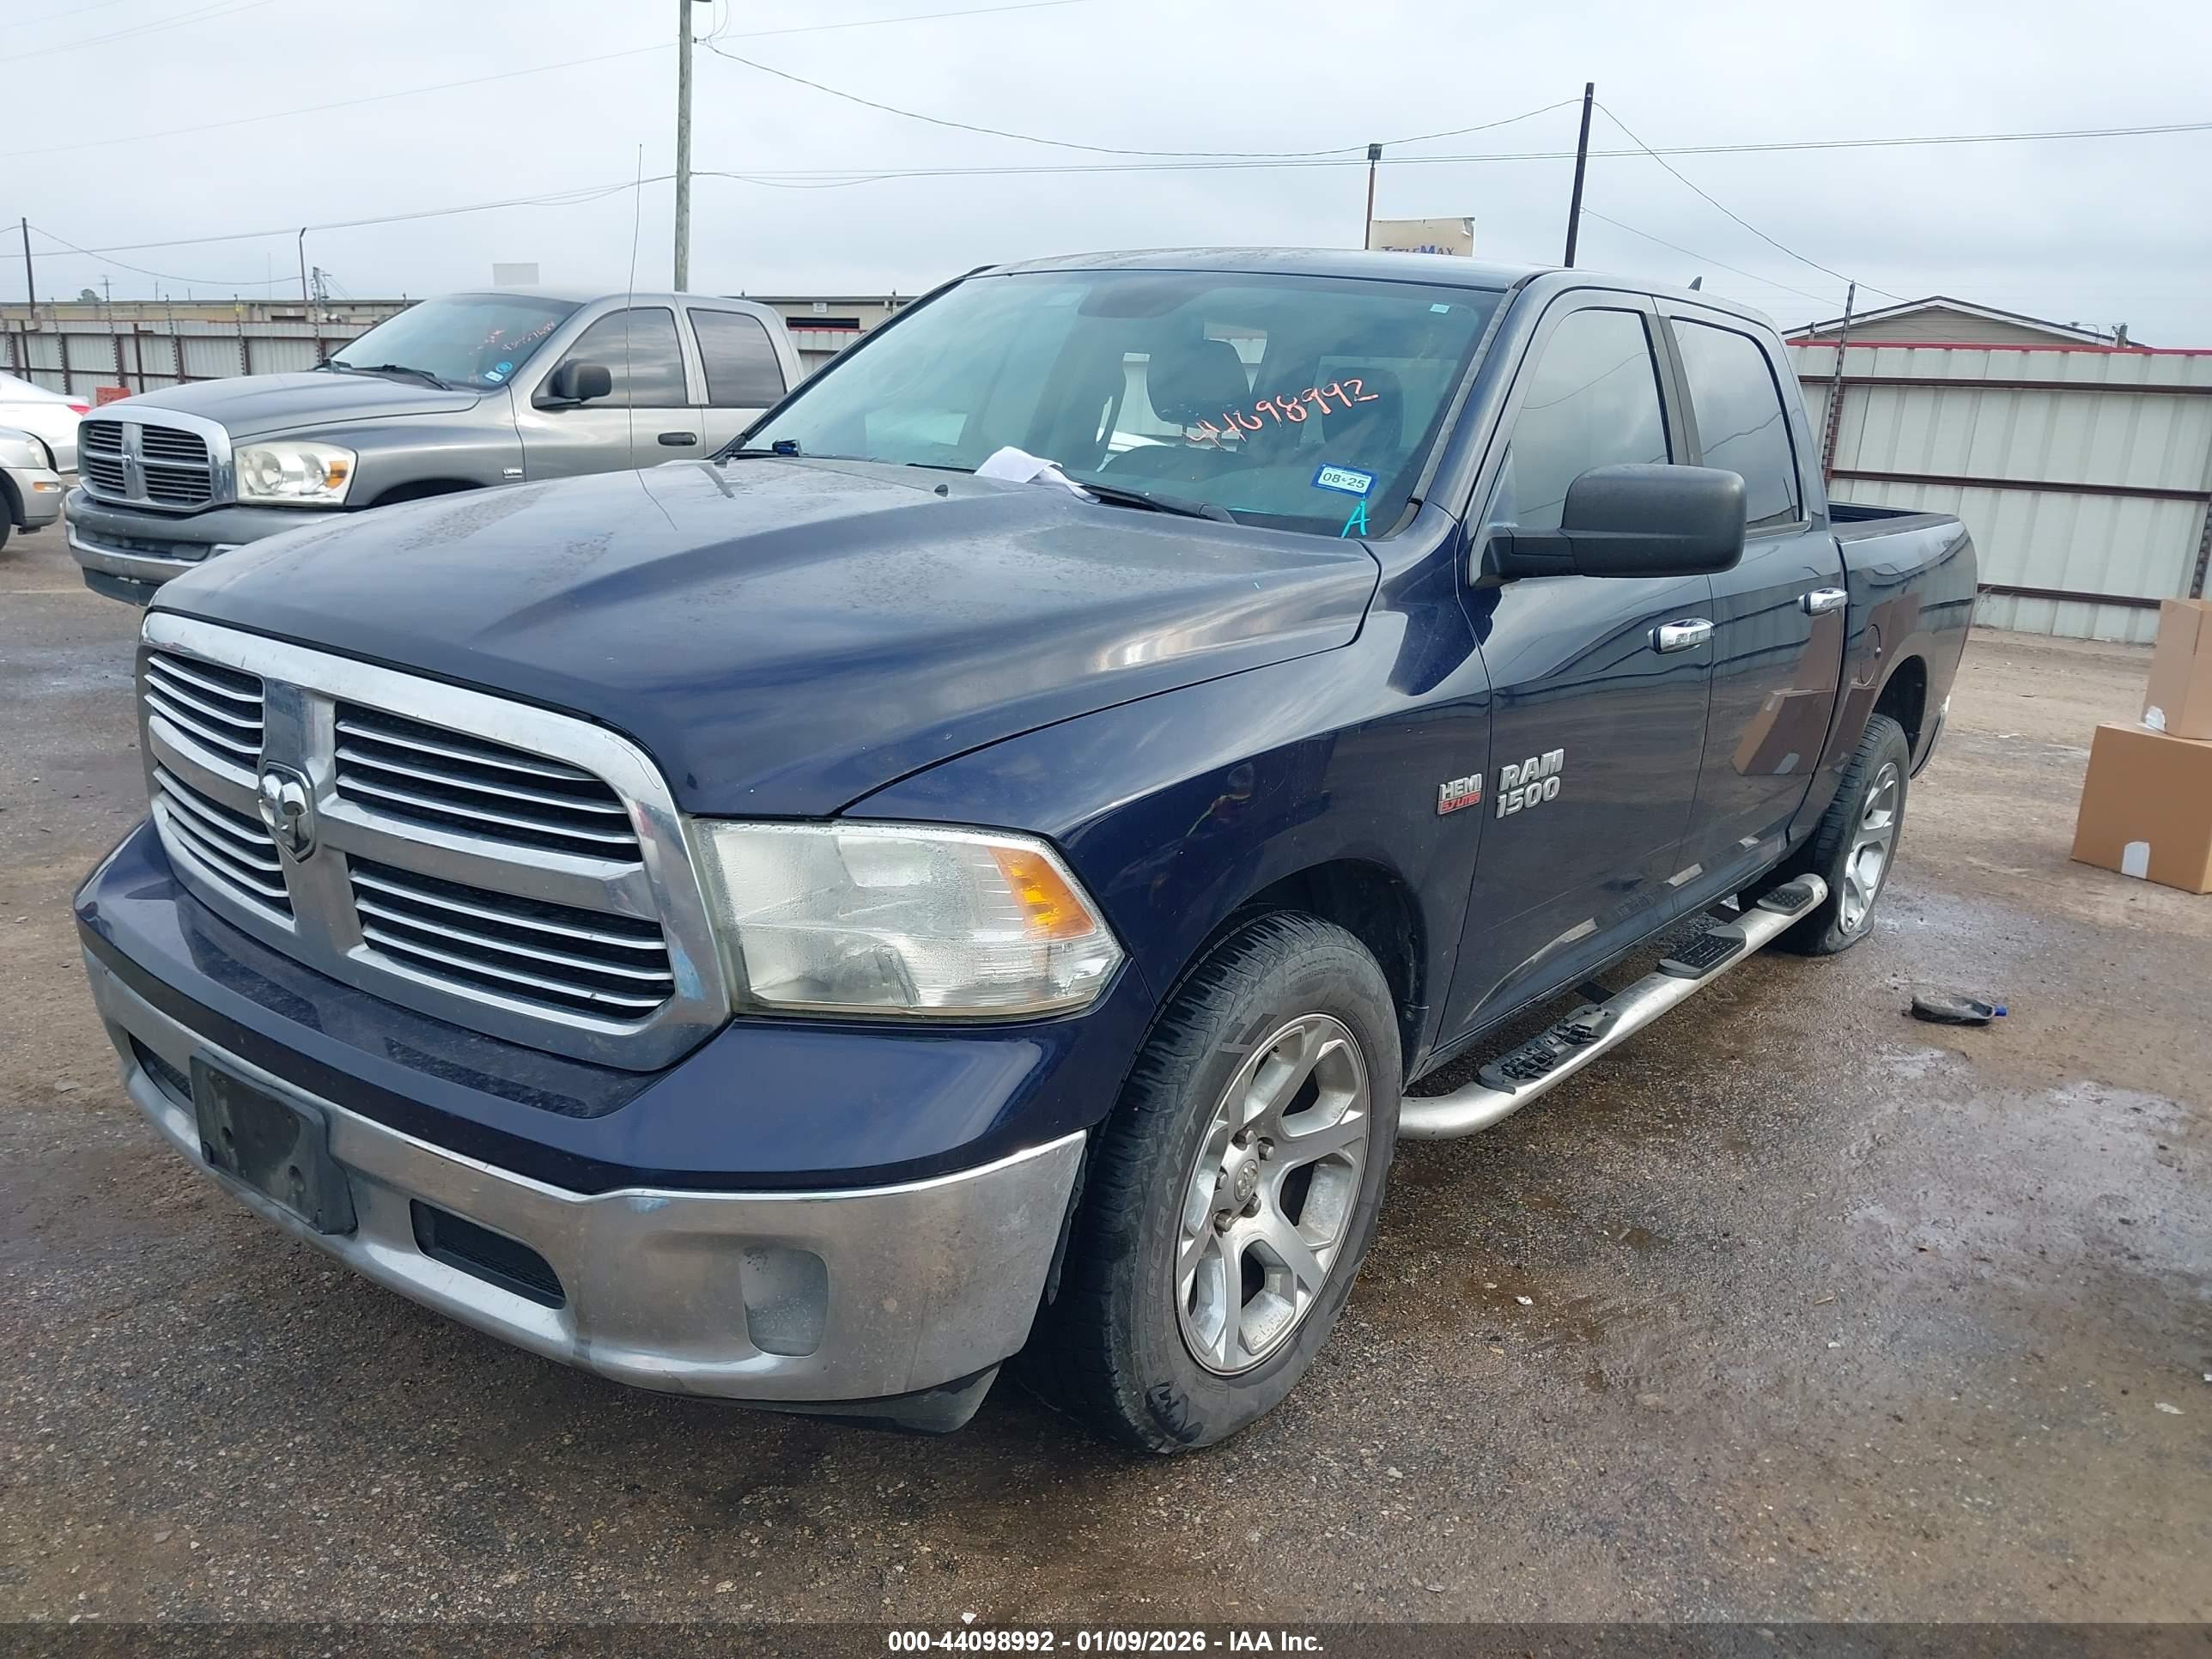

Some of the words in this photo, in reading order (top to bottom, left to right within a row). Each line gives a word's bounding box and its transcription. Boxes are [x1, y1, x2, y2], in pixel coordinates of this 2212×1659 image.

[1340, 499, 1370, 538] A
[1440, 773, 1482, 799] HEMI
[1499, 748, 1564, 791] RAM
[1496, 775, 1560, 819] 1500
